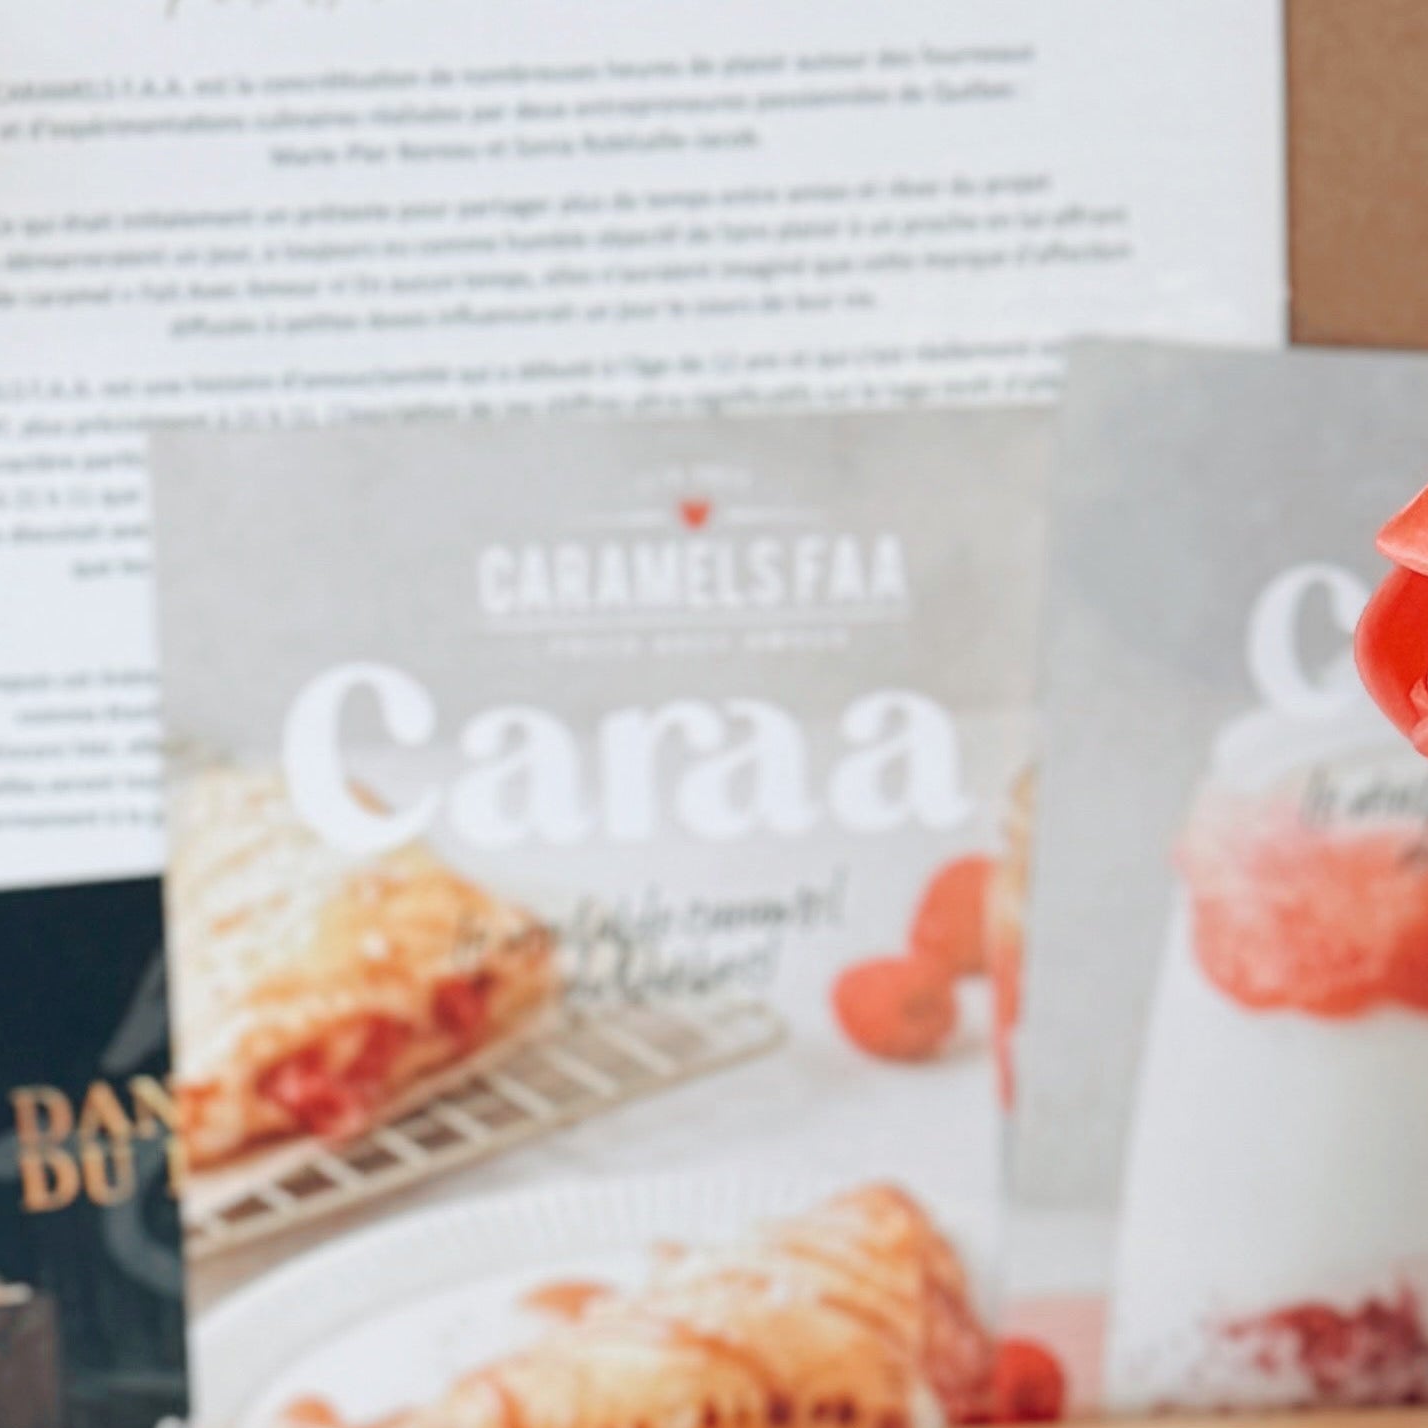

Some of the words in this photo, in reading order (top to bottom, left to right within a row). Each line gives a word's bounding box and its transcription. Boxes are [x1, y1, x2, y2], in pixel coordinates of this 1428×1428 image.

[478, 537, 787, 613] CARAMELS
[282, 661, 972, 855] Caraa
[19, 1143, 134, 1213] DU
